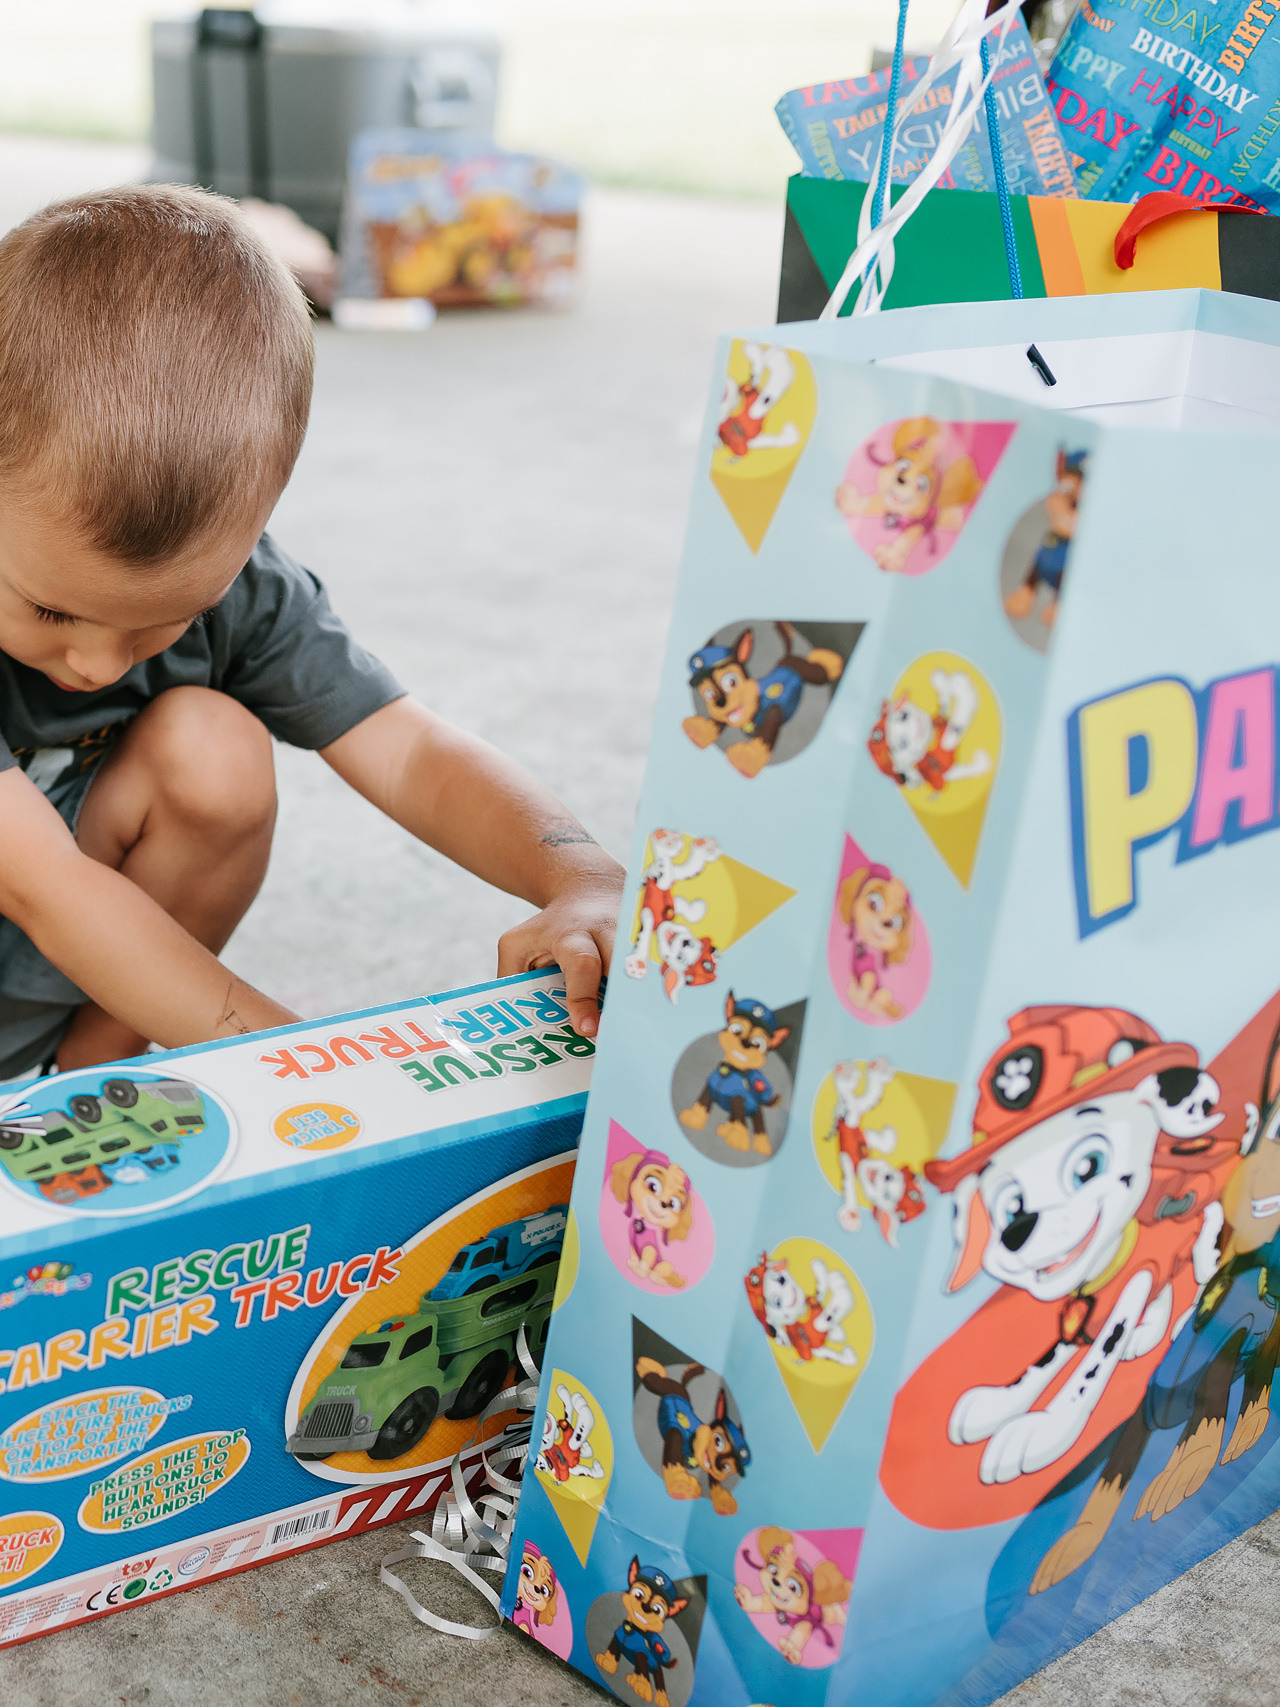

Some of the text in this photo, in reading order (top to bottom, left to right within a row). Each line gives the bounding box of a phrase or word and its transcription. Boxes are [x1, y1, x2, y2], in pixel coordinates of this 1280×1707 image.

[1129, 26, 1260, 115] BIRTHDAY
[1129, 68, 1239, 148] HAPPY
[1068, 665, 1280, 938] PA
[258, 1021, 450, 1079] TRUCK
[397, 1024, 596, 1095] RESCUE
[284, 1113, 360, 1147] 3 TRUCK
[106, 1224, 310, 1319] RESCUE
[231, 1246, 404, 1328] TRUCK
[40, 1391, 142, 1426] STACK THE
[54, 1422, 67, 1438] &
[72, 1411, 116, 1434] FIRE
[121, 1394, 193, 1423] TRUCKS
[326, 1384, 357, 1397] TRUCK
[4, 1419, 152, 1463] ON TOP OF THE
[8, 1433, 147, 1477] TRANSPORTER!
[90, 1427, 246, 1497] PRESS THE TOP
[102, 1465, 227, 1523] HEAR TRUCK
[103, 1450, 228, 1508] BUTTONS TO
[121, 1486, 206, 1531] SOUNDS!
[122, 1556, 157, 1576] toy
